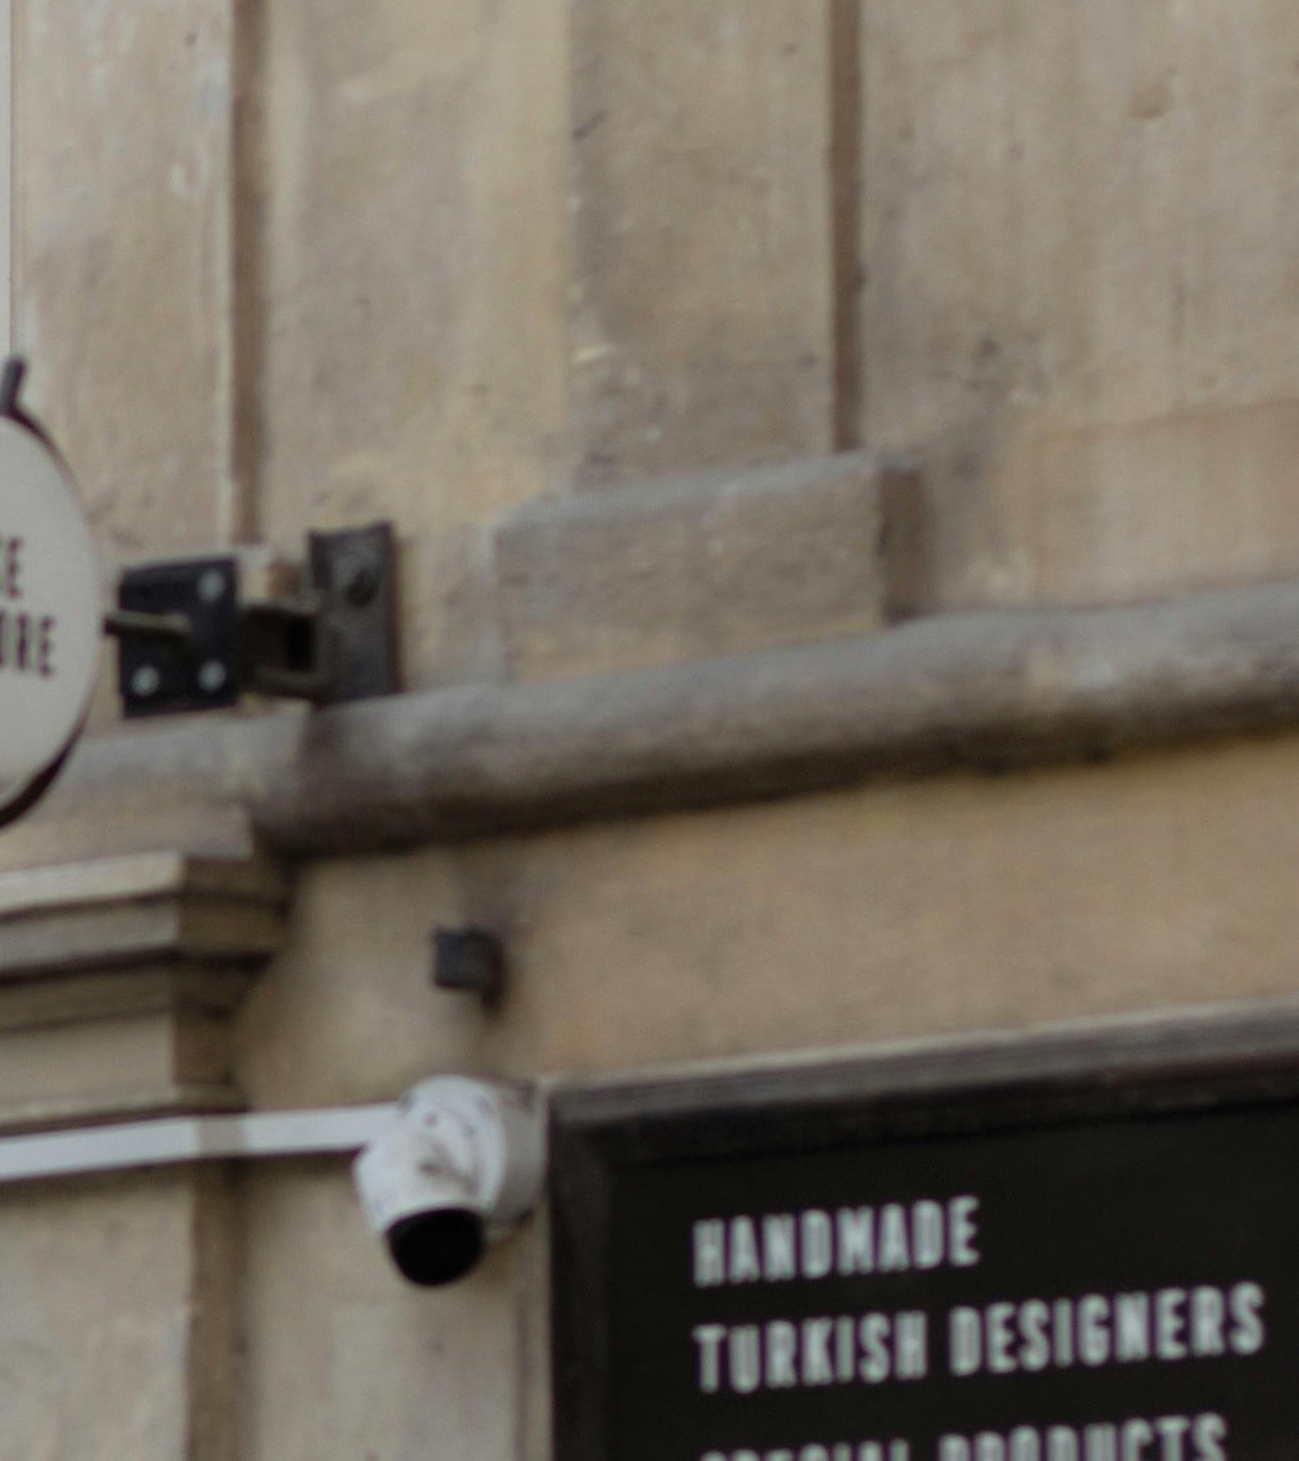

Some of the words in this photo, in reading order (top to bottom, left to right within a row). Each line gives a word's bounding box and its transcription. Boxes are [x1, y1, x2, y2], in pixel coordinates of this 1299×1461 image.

[694, 1196, 979, 1285] HANDMADE
[694, 1312, 927, 1392] TURKISH
[949, 1282, 1265, 1377] DESIGNERS
